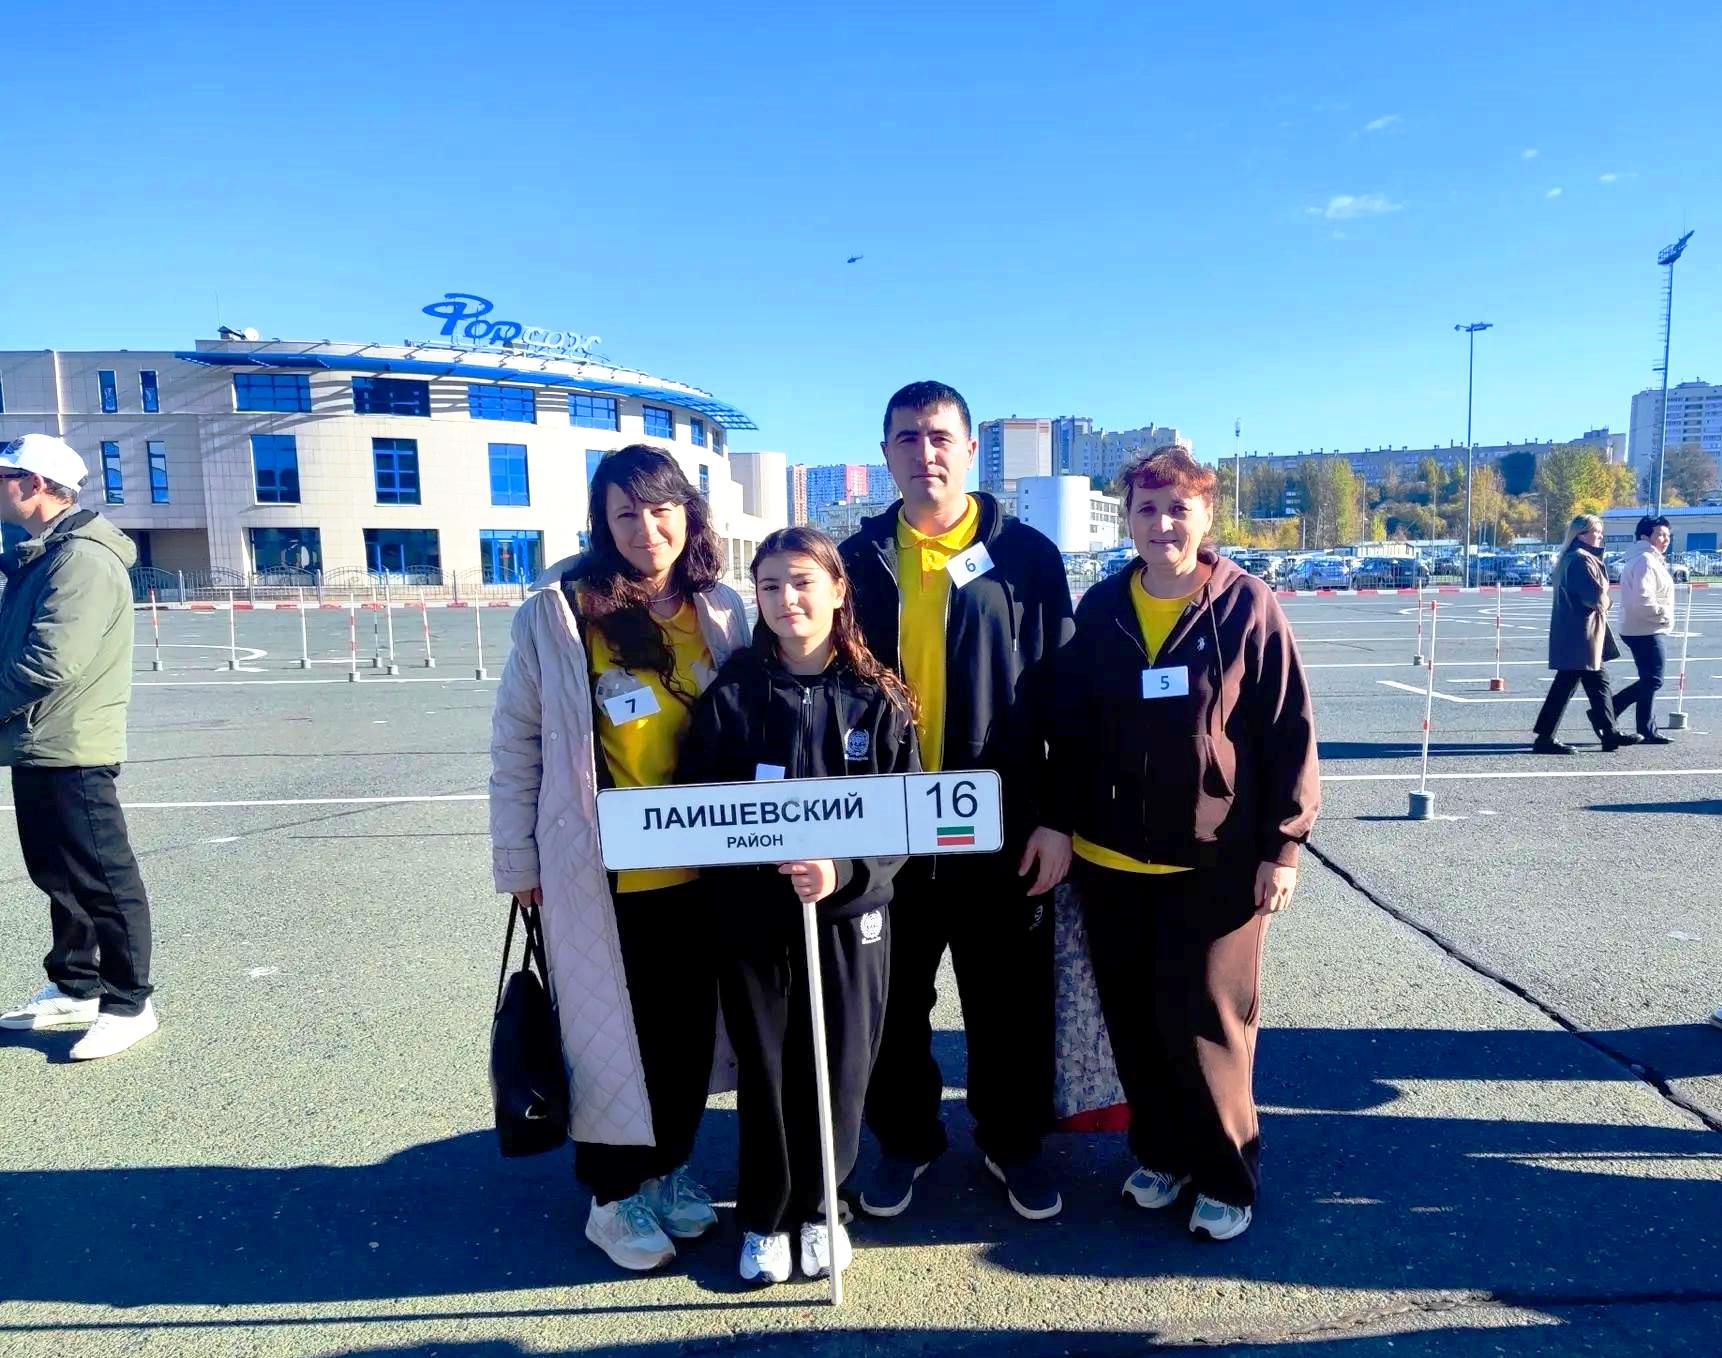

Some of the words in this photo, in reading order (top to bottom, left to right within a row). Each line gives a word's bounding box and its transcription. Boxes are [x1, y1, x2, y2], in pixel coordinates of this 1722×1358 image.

[965, 557, 977, 573] 6
[1160, 675, 1170, 690] 5
[624, 698, 636, 714] 7
[926, 780, 978, 819] 16
[642, 791, 864, 831] ЛАИШЕВСКИЙ
[726, 832, 784, 849] РАЙОН
